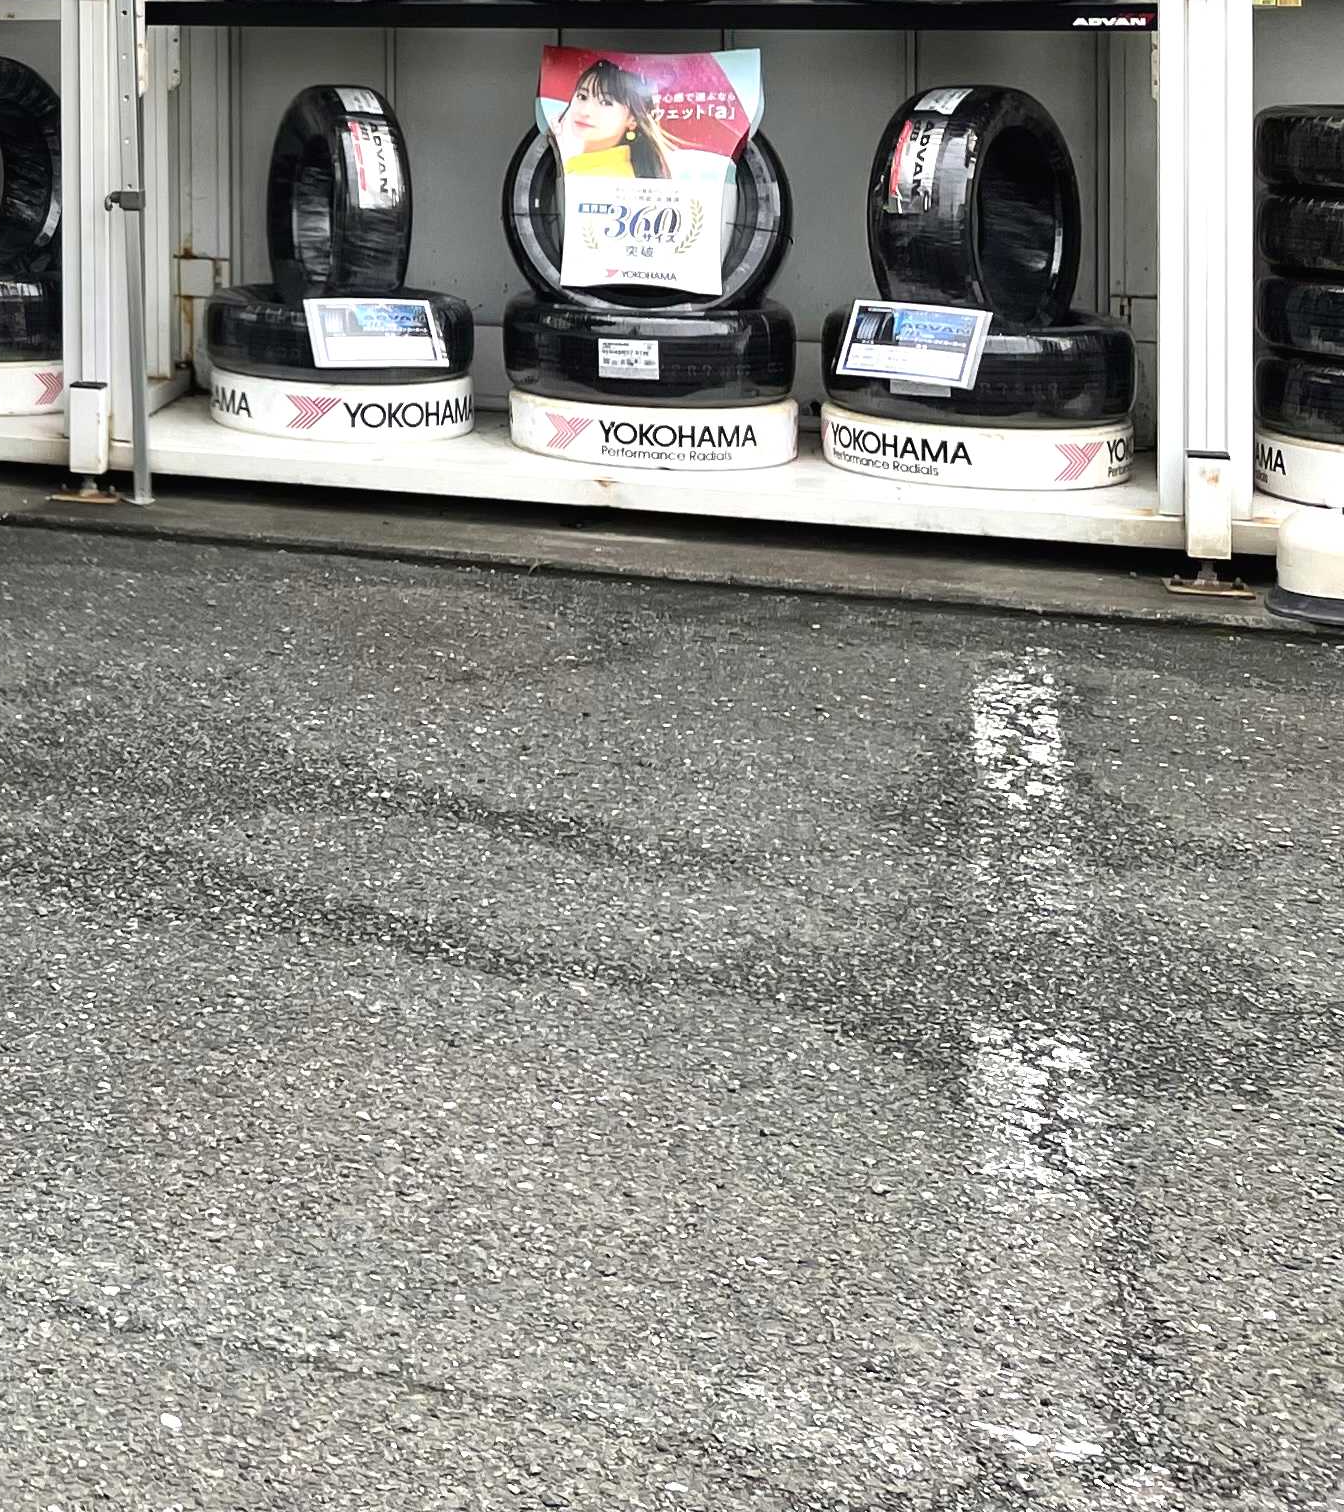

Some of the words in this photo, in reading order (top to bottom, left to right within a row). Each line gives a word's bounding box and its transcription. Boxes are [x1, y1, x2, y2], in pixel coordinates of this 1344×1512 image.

[1072, 17, 1147, 27] ADVAN
[604, 205, 682, 240] 360
[621, 271, 678, 282] YOKOHAMA
[344, 394, 474, 430] YOKOHAMA
[598, 419, 758, 449] YOKOHAMA
[830, 421, 973, 466] YOKOHAMA
[601, 445, 686, 462] Performance
[689, 449, 733, 462] Radials
[892, 460, 940, 477] Radials
